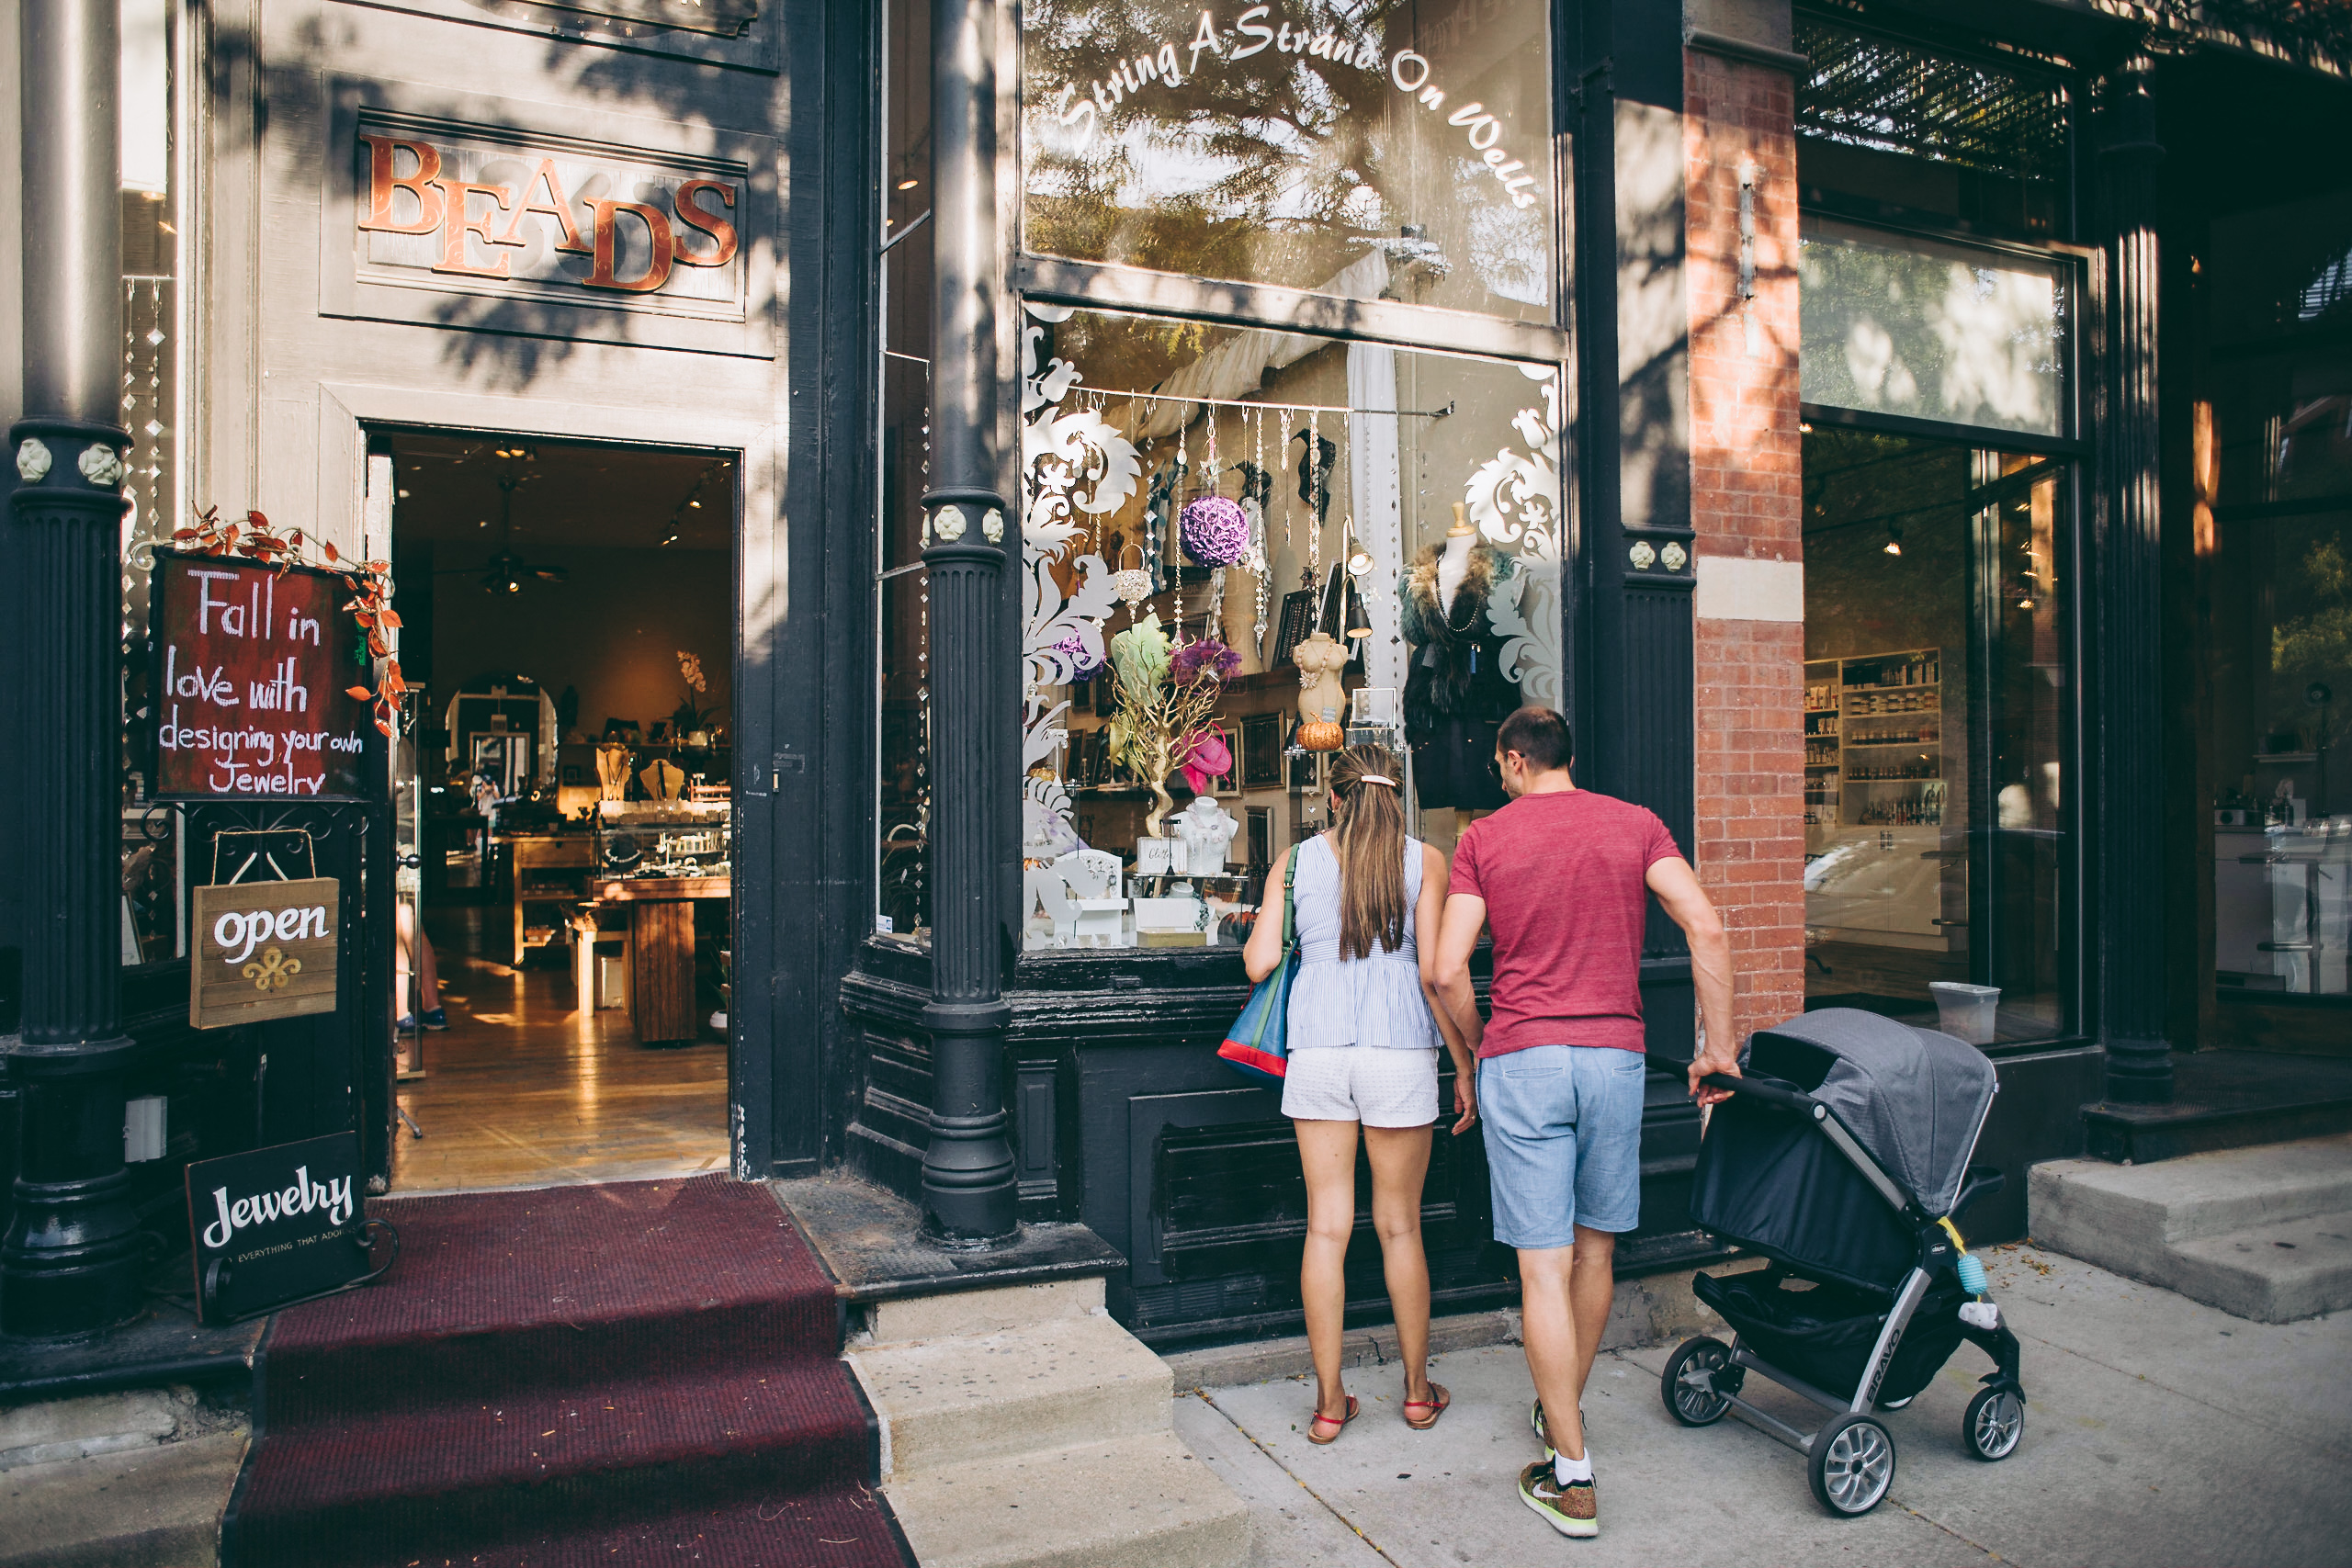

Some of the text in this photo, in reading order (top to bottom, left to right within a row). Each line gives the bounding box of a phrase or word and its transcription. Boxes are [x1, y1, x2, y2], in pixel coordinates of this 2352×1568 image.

[1058, 43, 1181, 159] String
[1189, 10, 1223, 74] A
[1229, 6, 1377, 70] Strand
[1392, 49, 1445, 110] On
[1448, 102, 1535, 209] Wells
[358, 134, 738, 295] BEADS
[187, 569, 321, 647] Fall in
[165, 645, 308, 713] love with
[159, 704, 363, 768] designing your own
[209, 761, 326, 795] Jewelry
[213, 906, 330, 964] open
[203, 1165, 354, 1248] Jewelry
[238, 1241, 293, 1263] EVERYTHING
[297, 1234, 318, 1247] THAT
[1867, 1328, 1901, 1404] BRAVO
